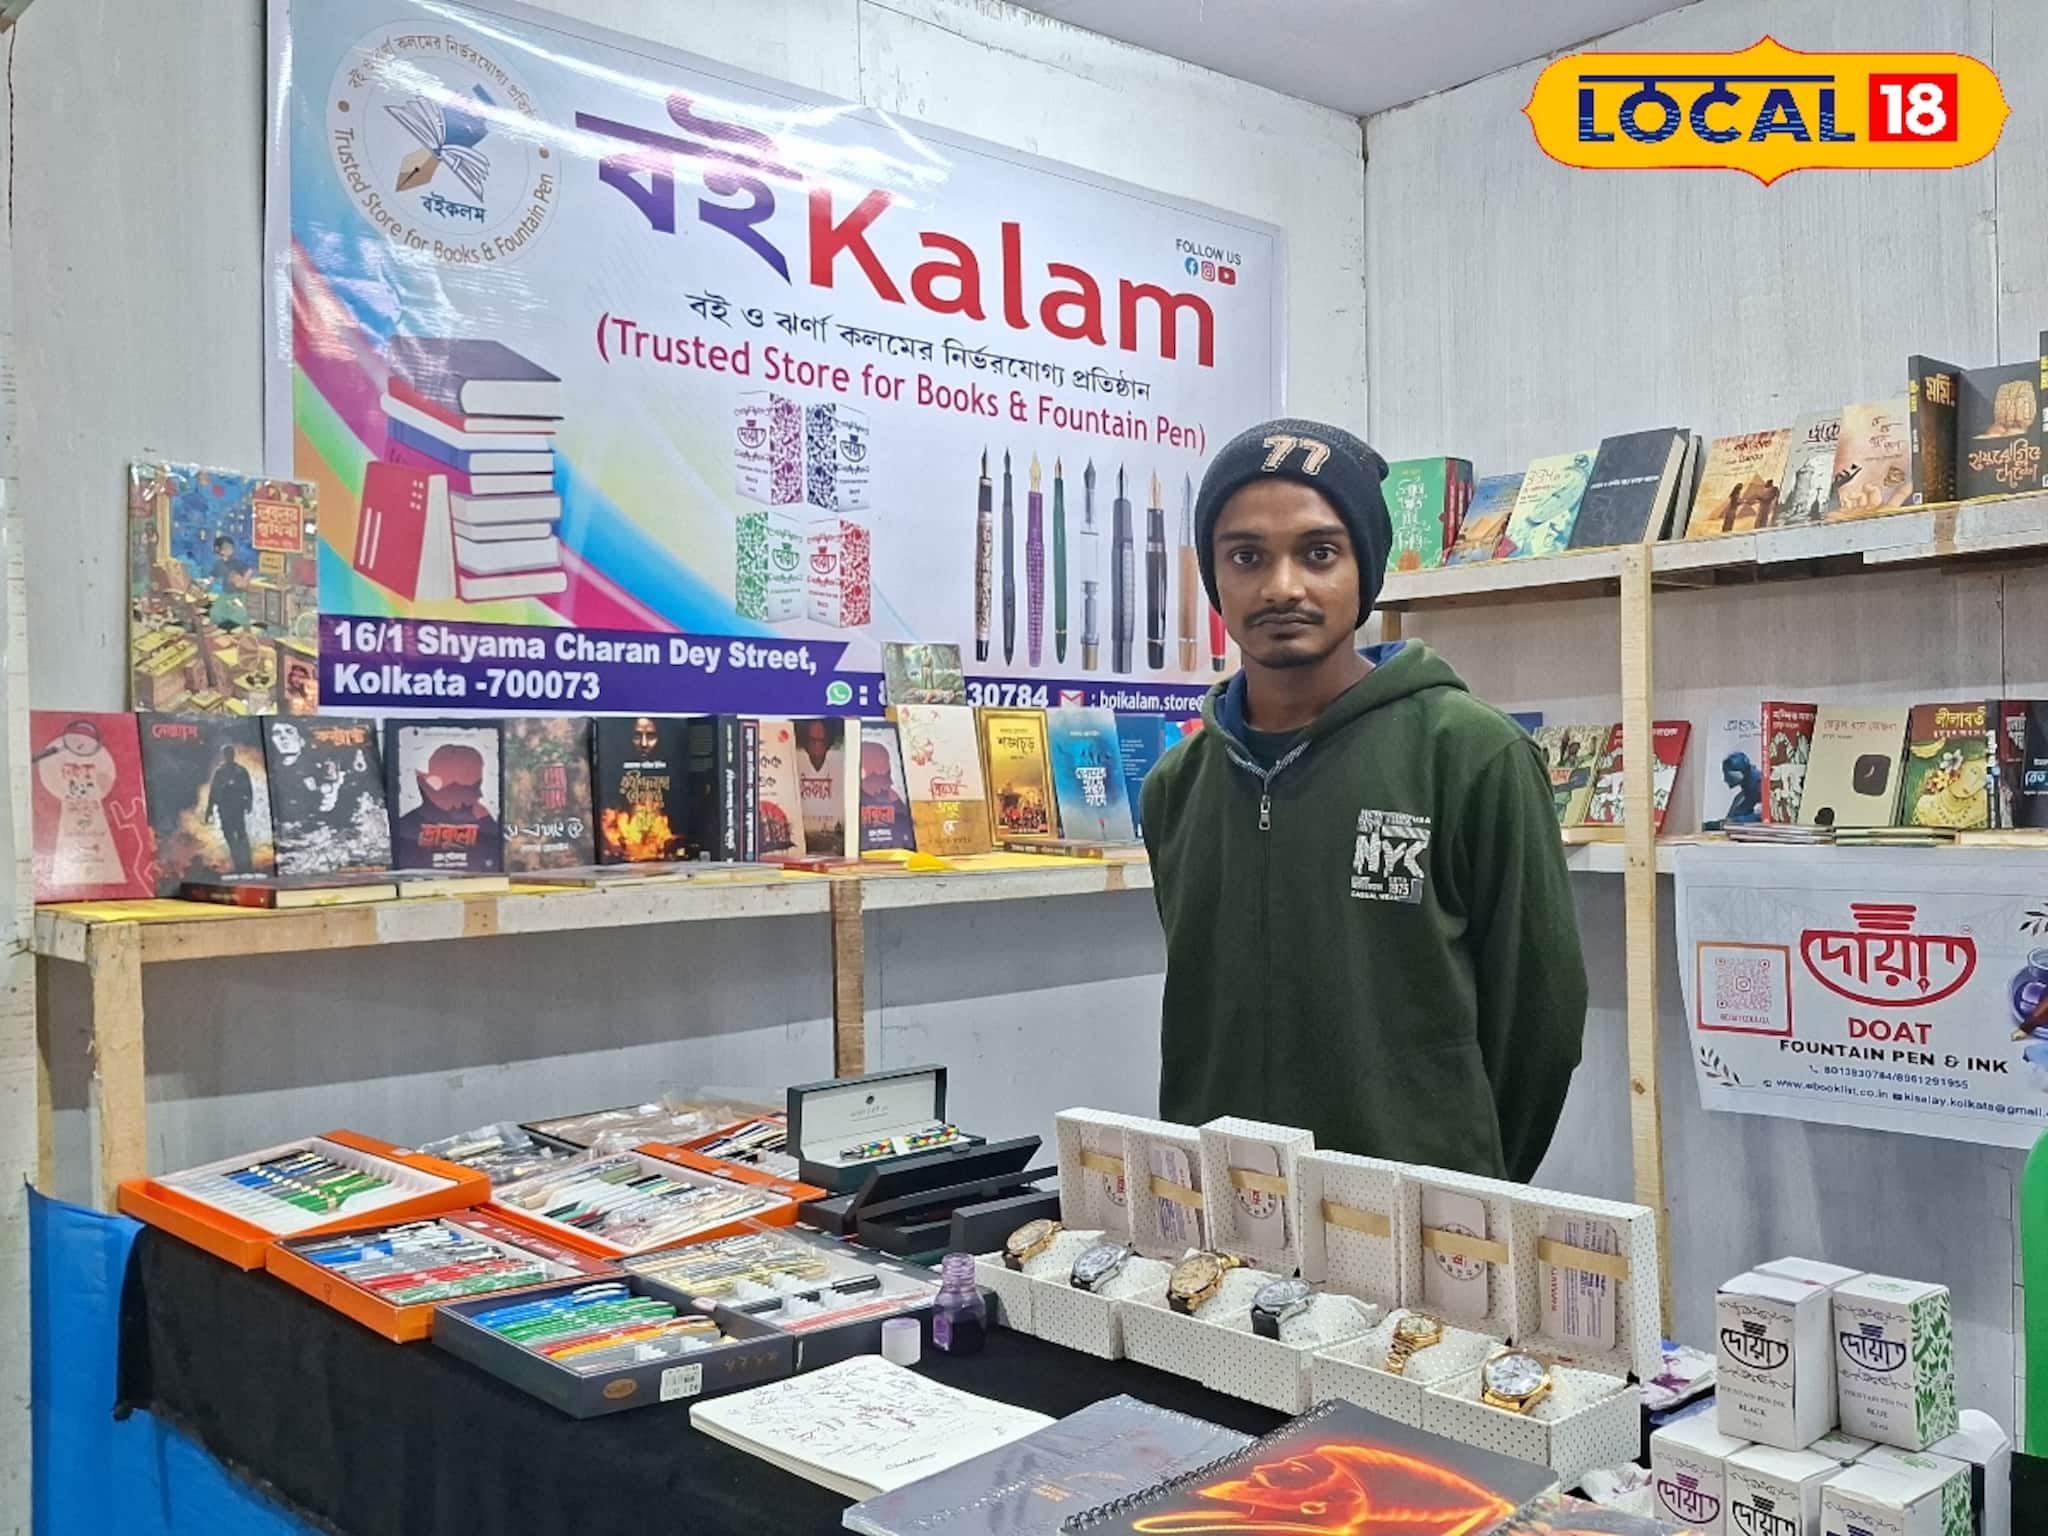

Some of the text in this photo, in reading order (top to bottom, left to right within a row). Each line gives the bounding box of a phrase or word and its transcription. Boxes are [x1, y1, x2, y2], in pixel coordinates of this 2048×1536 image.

[335, 127, 372, 194] Trusted
[361, 192, 403, 236] Store
[404, 227, 430, 253] for
[434, 240, 481, 264] Books
[494, 204, 546, 257] Fountain
[534, 173, 554, 204] Pen
[420, 191, 487, 224] বইকলম
[1175, 239, 1242, 266] FOLLOW US
[684, 290, 1152, 402] বই ও ঝর্ণা কলমের নির্ভরযোগ্য প্রতিষ্ঠান
[597, 312, 1206, 457] (Trusted Store for Books & Fountain Pen)
[1261, 434, 1331, 476] 77
[335, 620, 818, 677] 16/1 Shyama Charan Dey Street,
[335, 663, 602, 702] Kolkata -700073
[1847, 1016, 1933, 1045] DOAT
[1779, 1039, 2009, 1074] FOUNTAIN PEN & INK
[1903, 1091, 2048, 1118] kisalay.kolkata@gmail.
